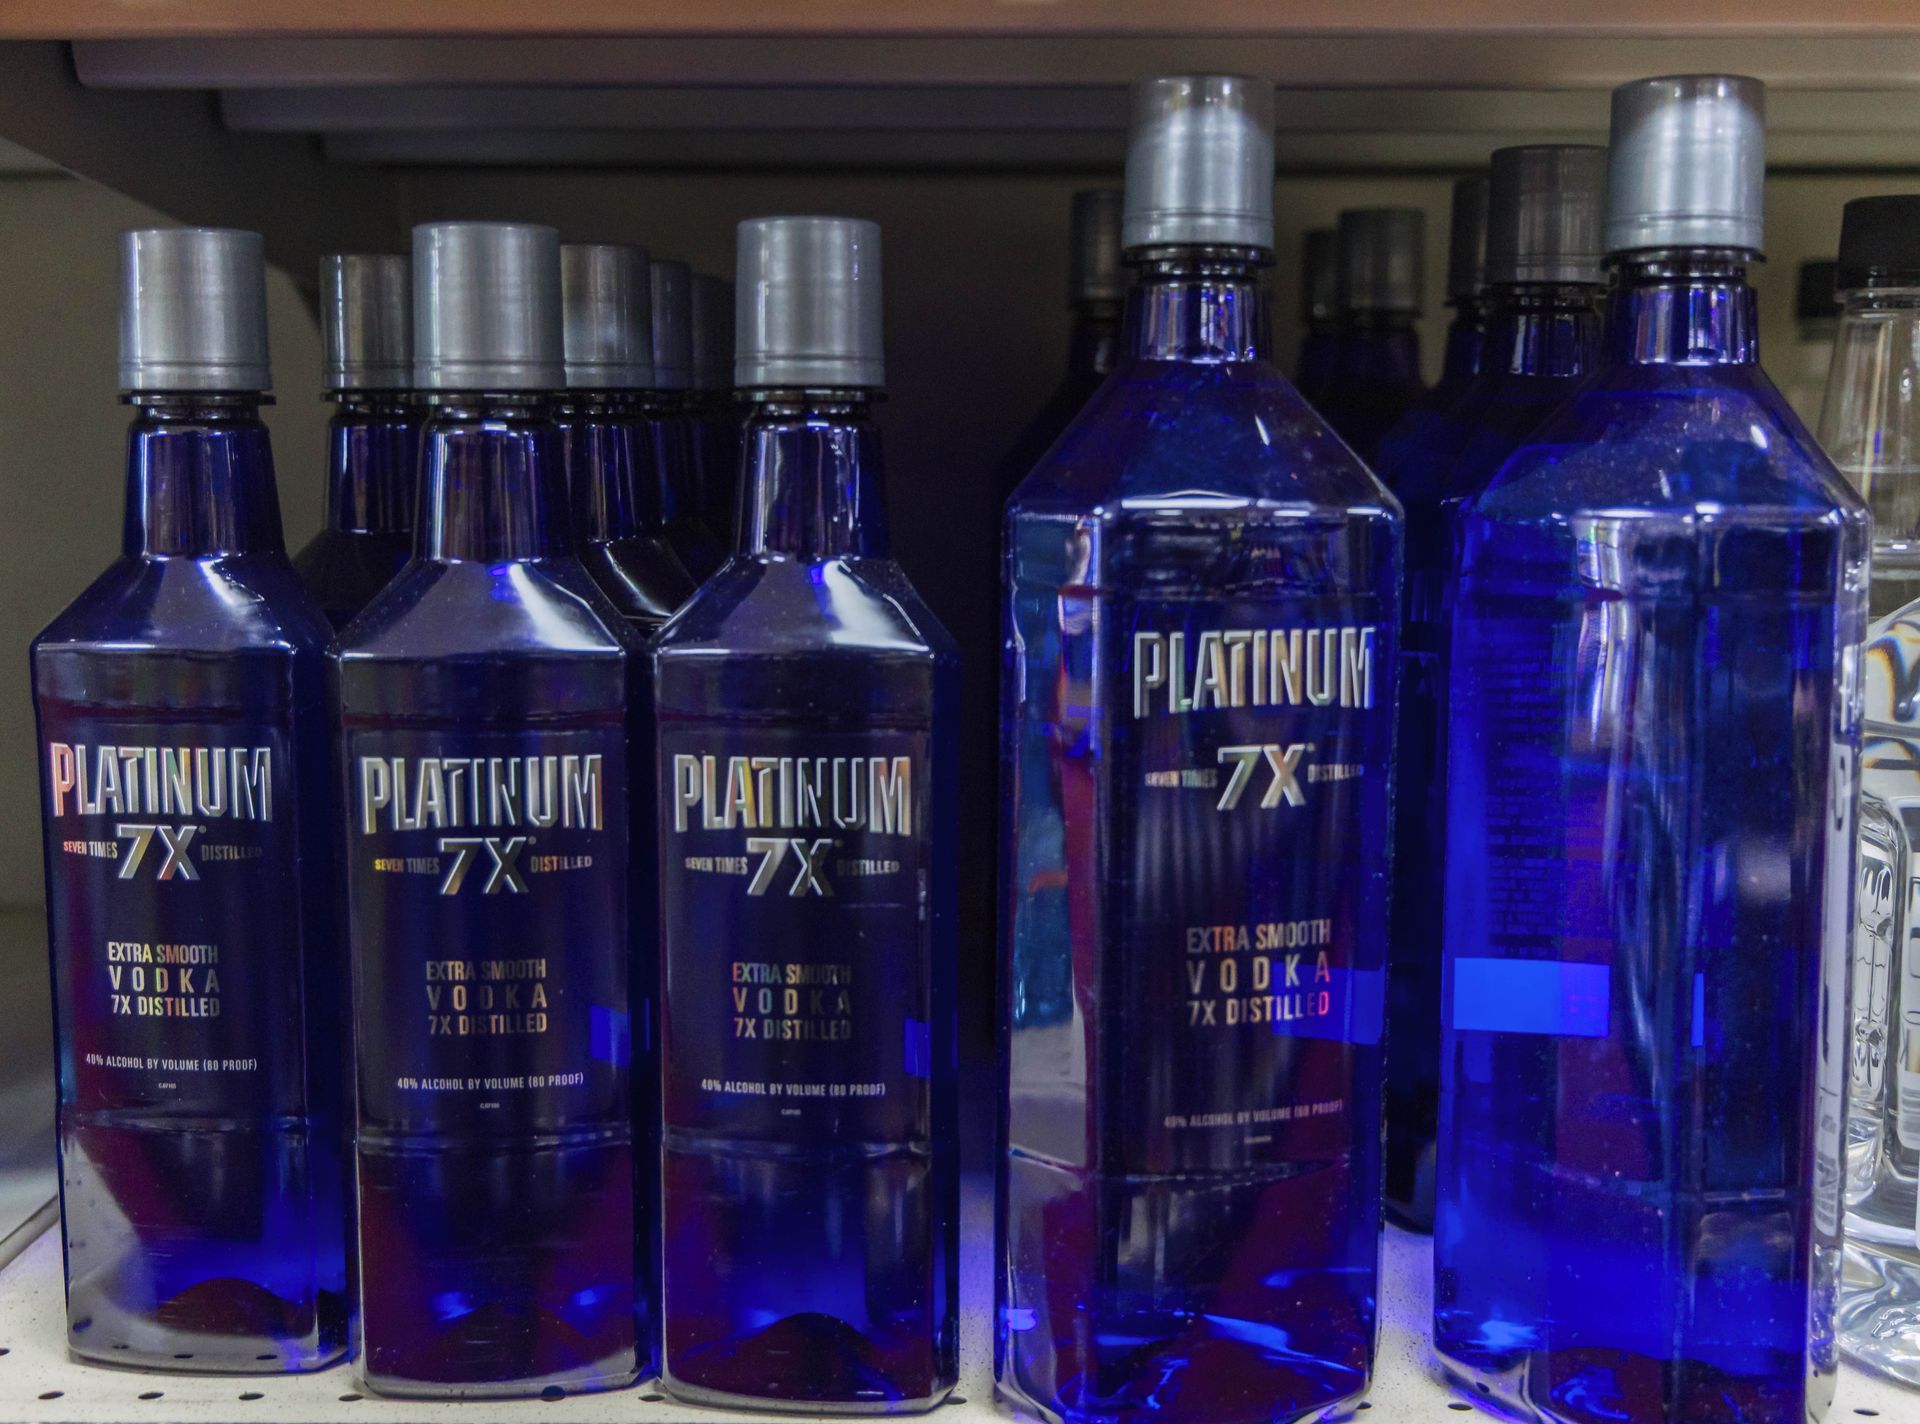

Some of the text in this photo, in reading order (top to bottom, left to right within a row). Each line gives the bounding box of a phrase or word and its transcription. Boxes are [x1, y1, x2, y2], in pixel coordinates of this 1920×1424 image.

[1134, 626, 1376, 719] PLATINUM
[50, 742, 272, 822] PLATINUM
[361, 754, 602, 834] PLATINUM
[674, 754, 911, 836] PLATINUM
[63, 841, 87, 855] SEVEN
[89, 841, 118, 859] TIMES
[374, 859, 403, 872] SEVEN
[406, 857, 440, 874] TIMES
[530, 856, 593, 873] DISTILLED
[685, 857, 713, 871] SEVEN
[715, 857, 748, 874] TIMES
[837, 859, 900, 876] DISTILLED
[1186, 919, 1331, 953] EXTRA SMOOTH
[108, 941, 218, 964] EXTRA SMOOTH
[108, 965, 220, 993] VODKA
[426, 958, 547, 981] EXTRA SMOOTH
[733, 962, 850, 985] EXTRA SMOOTH
[1186, 951, 1331, 995] VODKA
[111, 995, 220, 1016] 7X DISTILLED
[426, 983, 547, 1011] VODKA
[733, 987, 851, 1015] VODKA
[1186, 991, 1330, 1026] 7X DISTILLED
[428, 1013, 547, 1036] 7X DISTILLED
[734, 1017, 851, 1040] 7X DISTILLED
[86, 1053, 257, 1071] 40% ALCOHOL BY VOLUME (80 PROOF)
[397, 1072, 584, 1090] 40% ALCOHOL BY VOLUME (80 PROOF)
[702, 1079, 721, 1092] 40%
[724, 1081, 766, 1094] ALCOHOL
[770, 1082, 782, 1095] BY
[786, 1083, 825, 1096] VOLUME
[850, 1082, 886, 1096] PROOF)
